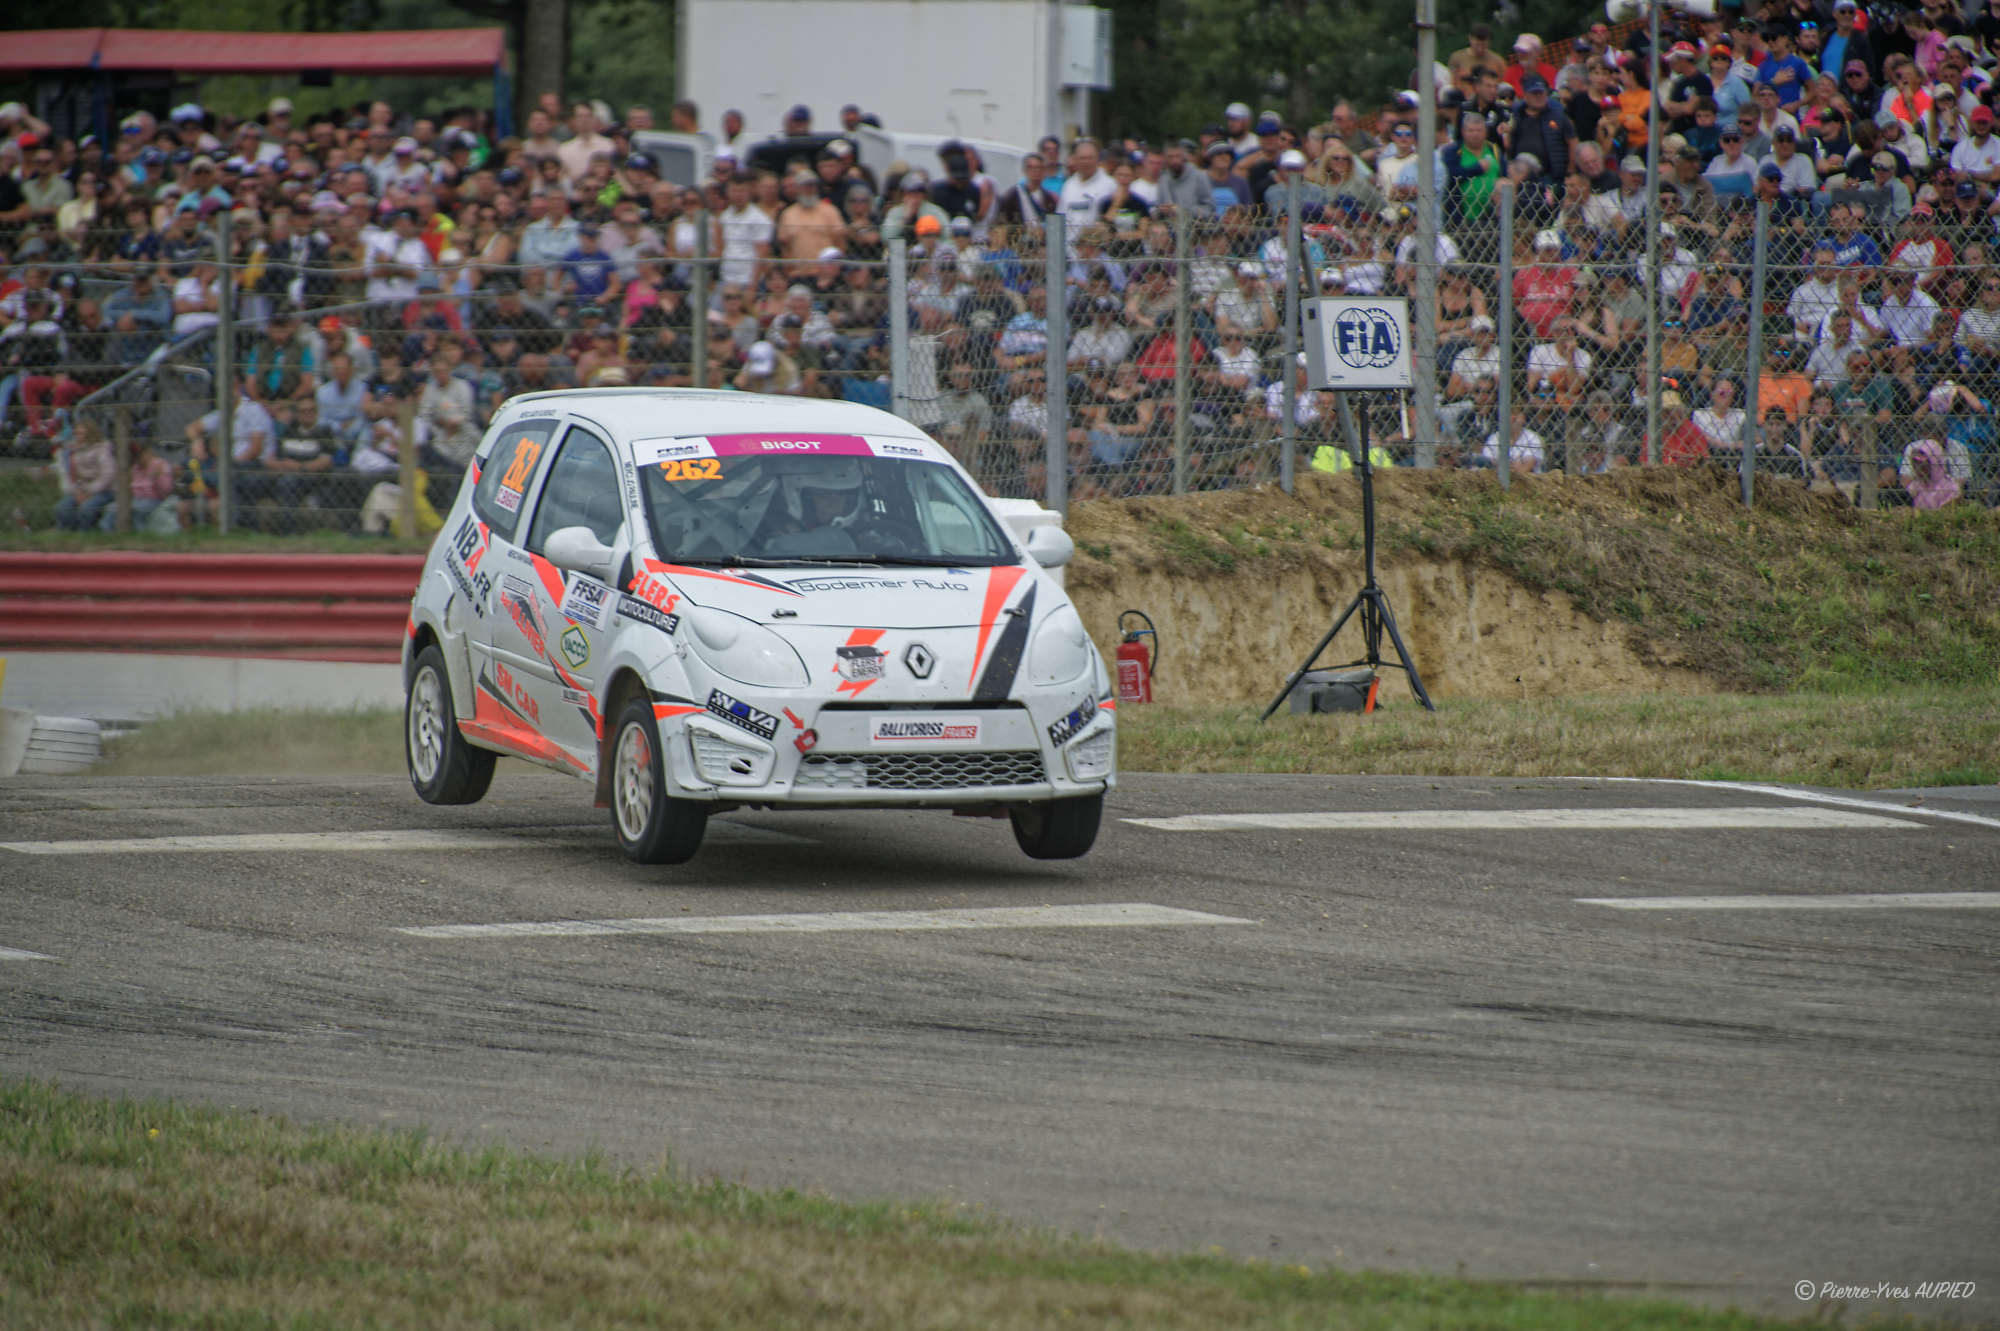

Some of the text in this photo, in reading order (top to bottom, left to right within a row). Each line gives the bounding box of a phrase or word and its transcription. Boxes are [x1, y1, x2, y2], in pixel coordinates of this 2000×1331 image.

[760, 441, 821, 450] BIGOT
[501, 437, 541, 494] 262
[660, 458, 724, 482] 262
[572, 579, 601, 606] FFSA
[628, 570, 681, 614] FLERS
[798, 579, 969, 592] Bodemer Auto
[619, 597, 677, 631] MOTOCULTURE
[515, 683, 541, 725] CAR
[879, 722, 977, 738] RALLYCROSS FRANCE
